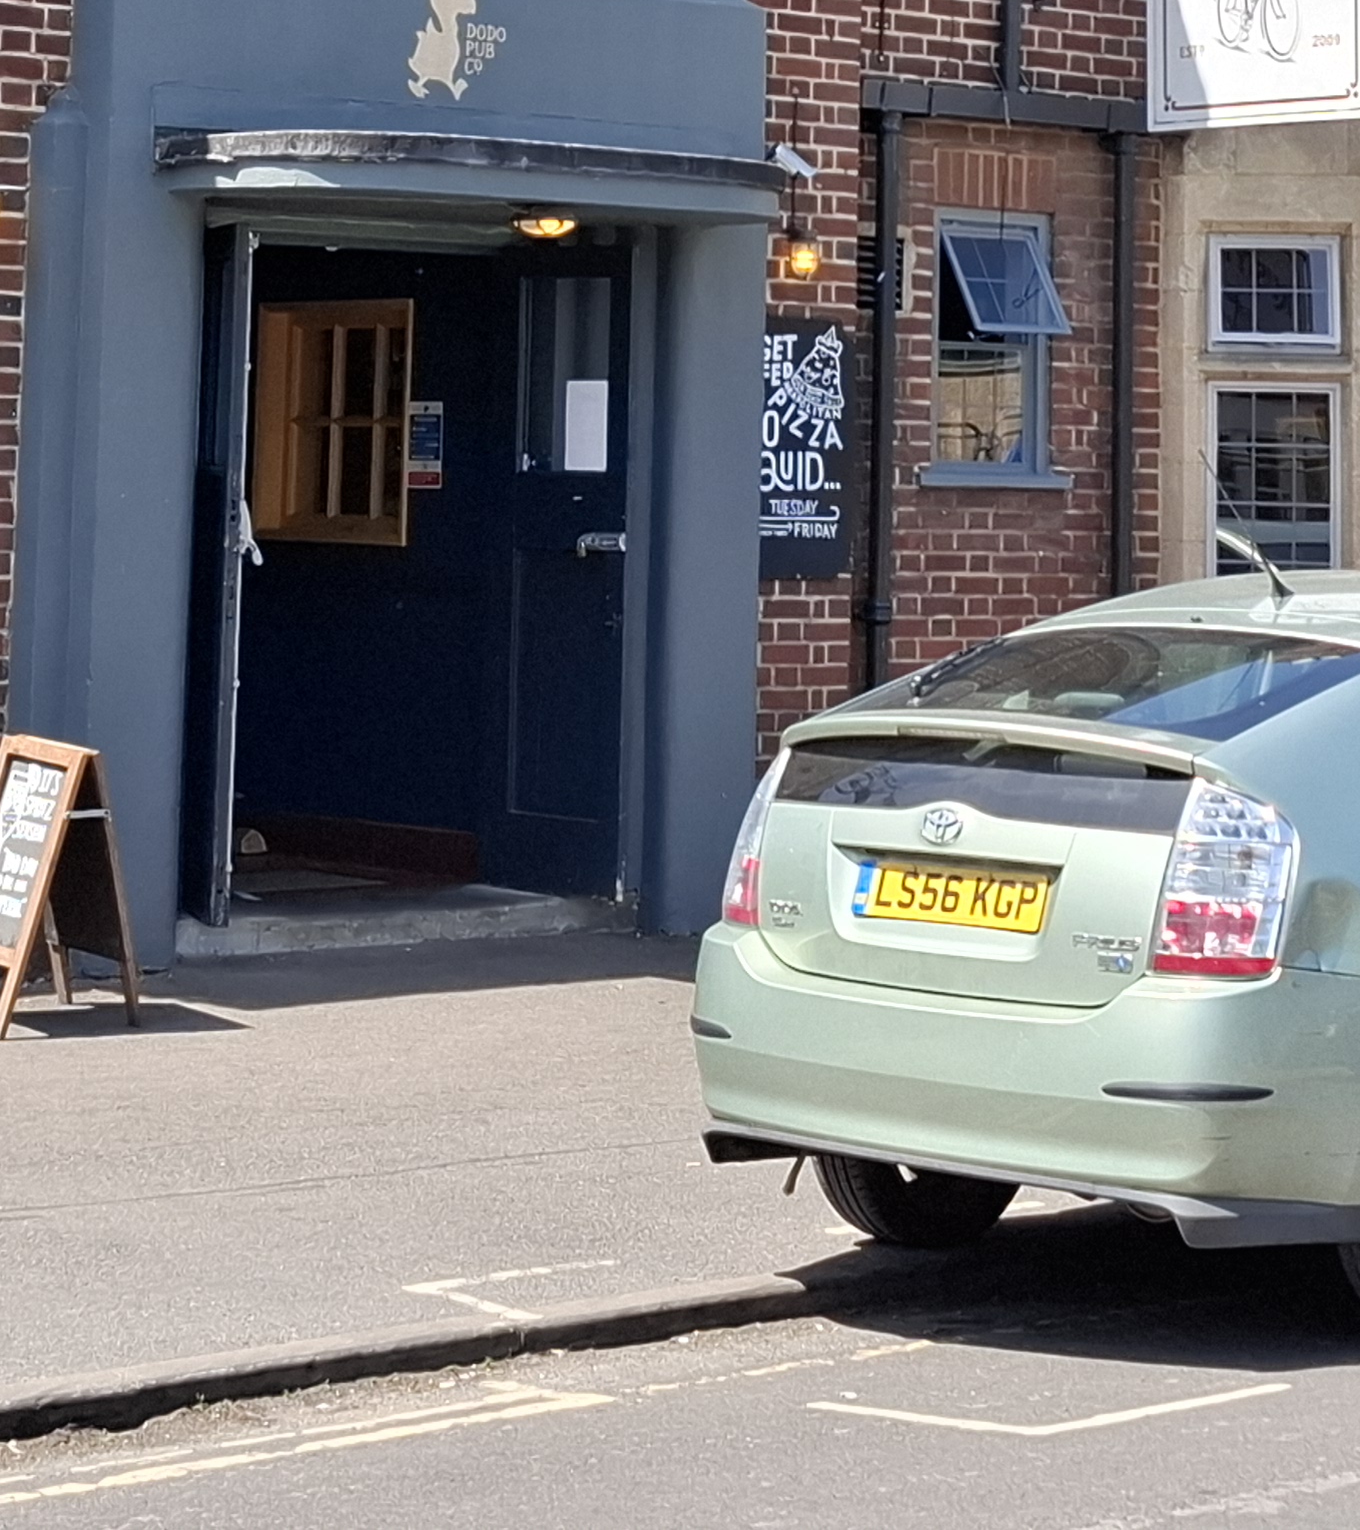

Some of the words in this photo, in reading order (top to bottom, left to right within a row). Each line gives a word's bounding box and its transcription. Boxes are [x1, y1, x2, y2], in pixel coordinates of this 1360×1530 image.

[466, 22, 507, 43] DODO
[465, 40, 495, 59] PUB
[767, 387, 844, 450] PIZZA
[768, 499, 819, 516] TUESDAY
[793, 522, 838, 540] FRIDAY
[875, 867, 964, 913] LS56
[969, 877, 1039, 920] KGP
